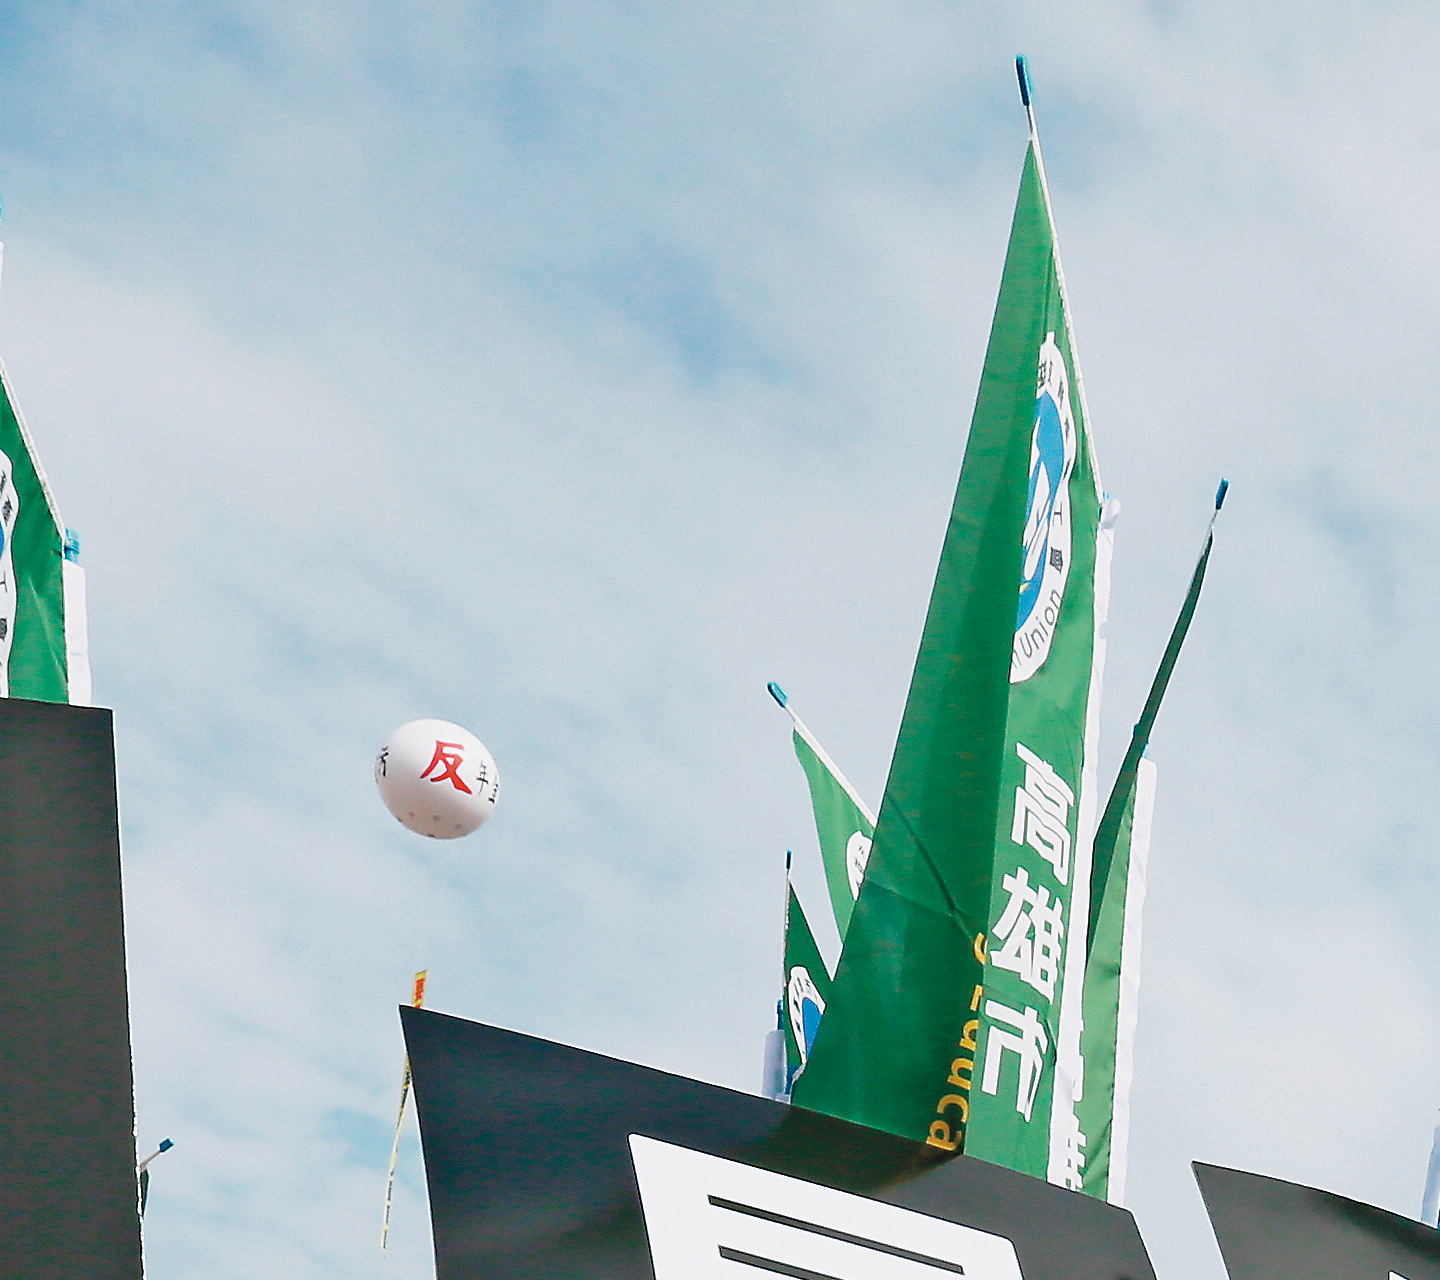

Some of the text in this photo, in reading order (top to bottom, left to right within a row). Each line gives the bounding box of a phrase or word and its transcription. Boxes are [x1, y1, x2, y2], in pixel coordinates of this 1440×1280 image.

[1020, 591, 1062, 659] Union
[420, 740, 472, 795] 反
[981, 742, 1074, 1122] 高雄市
